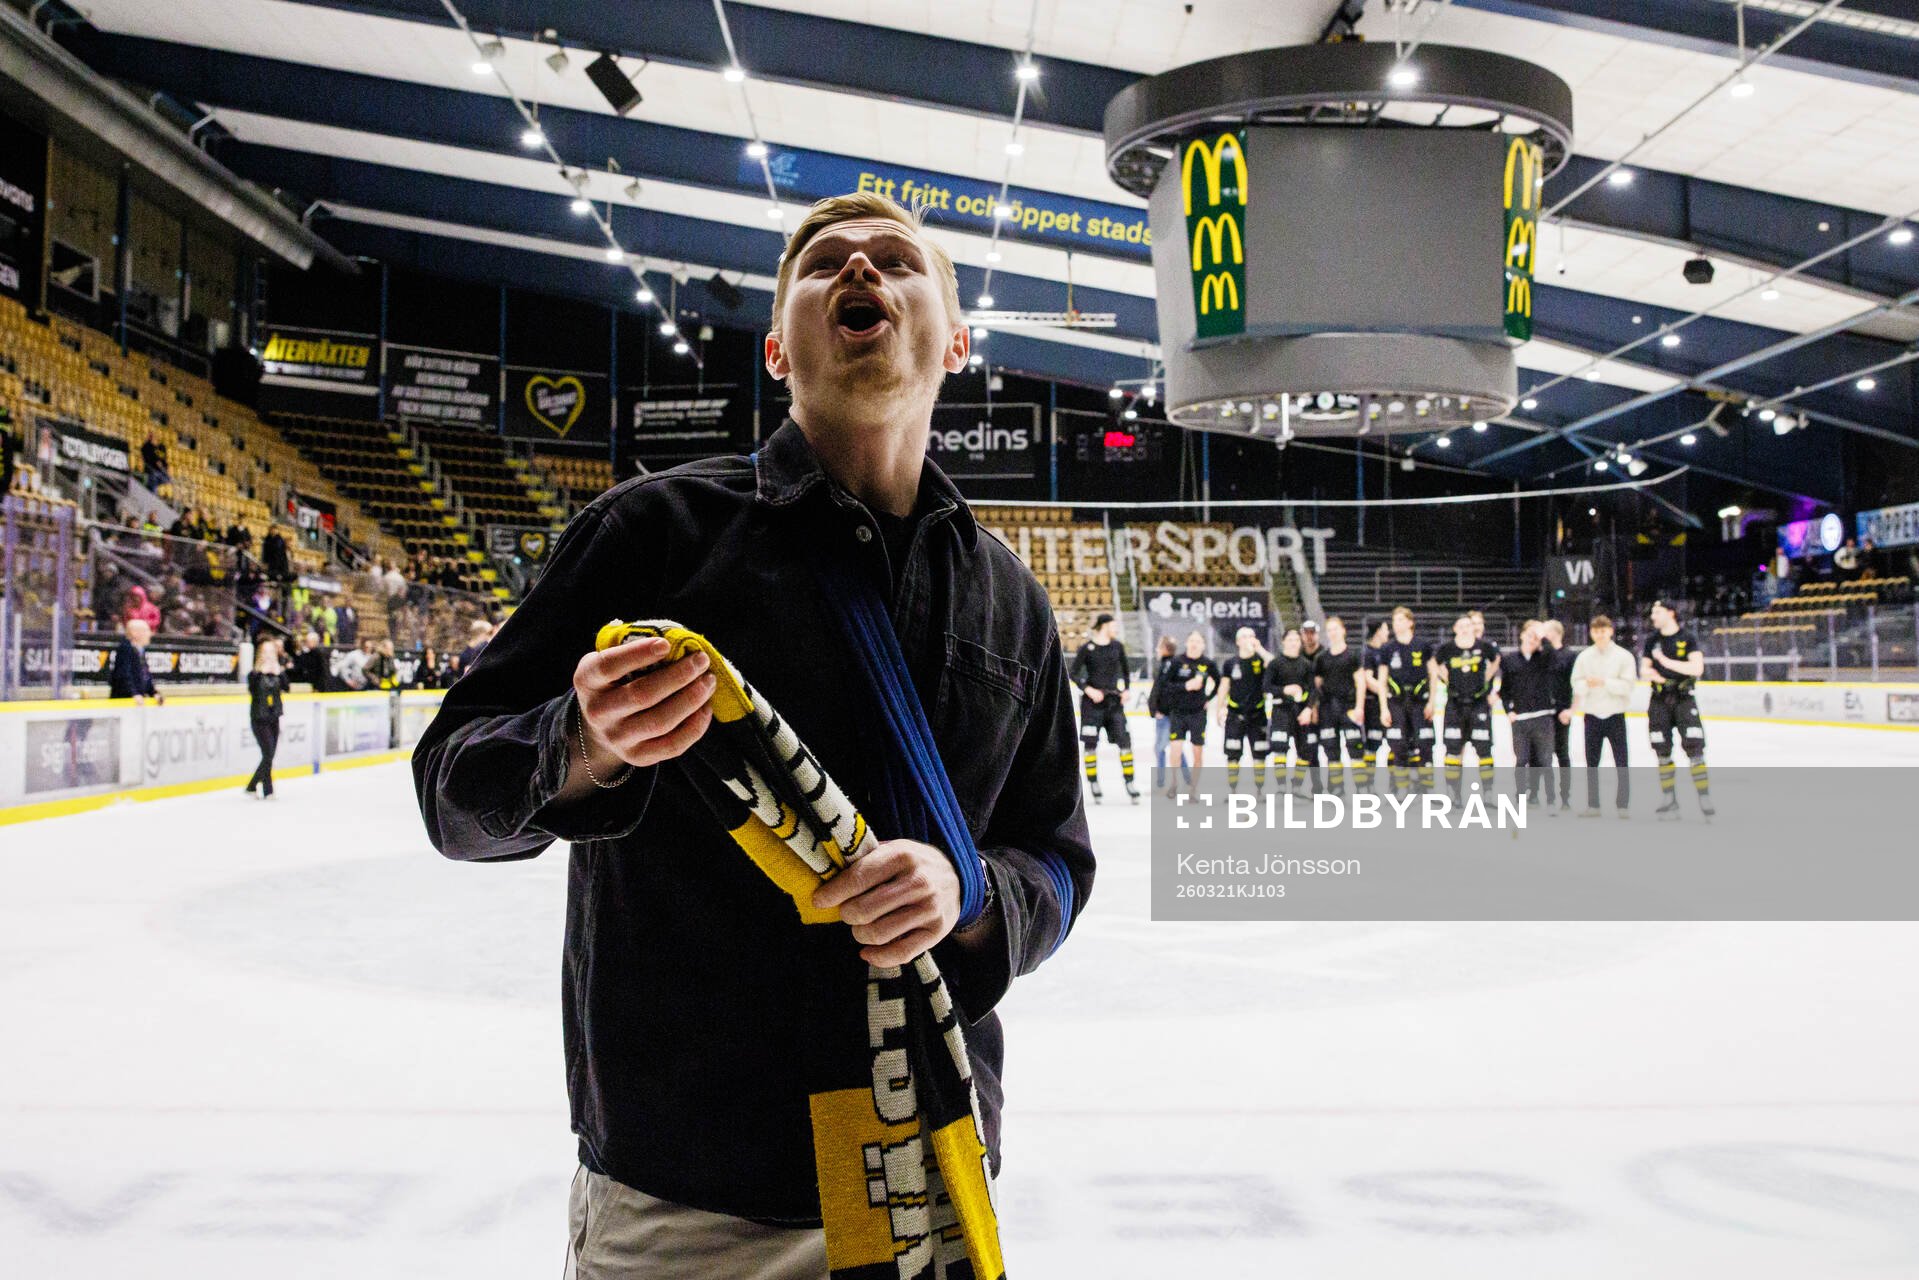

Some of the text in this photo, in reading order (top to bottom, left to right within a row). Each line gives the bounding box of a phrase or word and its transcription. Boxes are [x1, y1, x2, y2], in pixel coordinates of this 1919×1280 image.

[857, 172, 896, 200] Ett
[902, 180, 951, 210] fritt
[1009, 200, 1082, 233] öppet
[1177, 597, 1264, 618] Telexia
